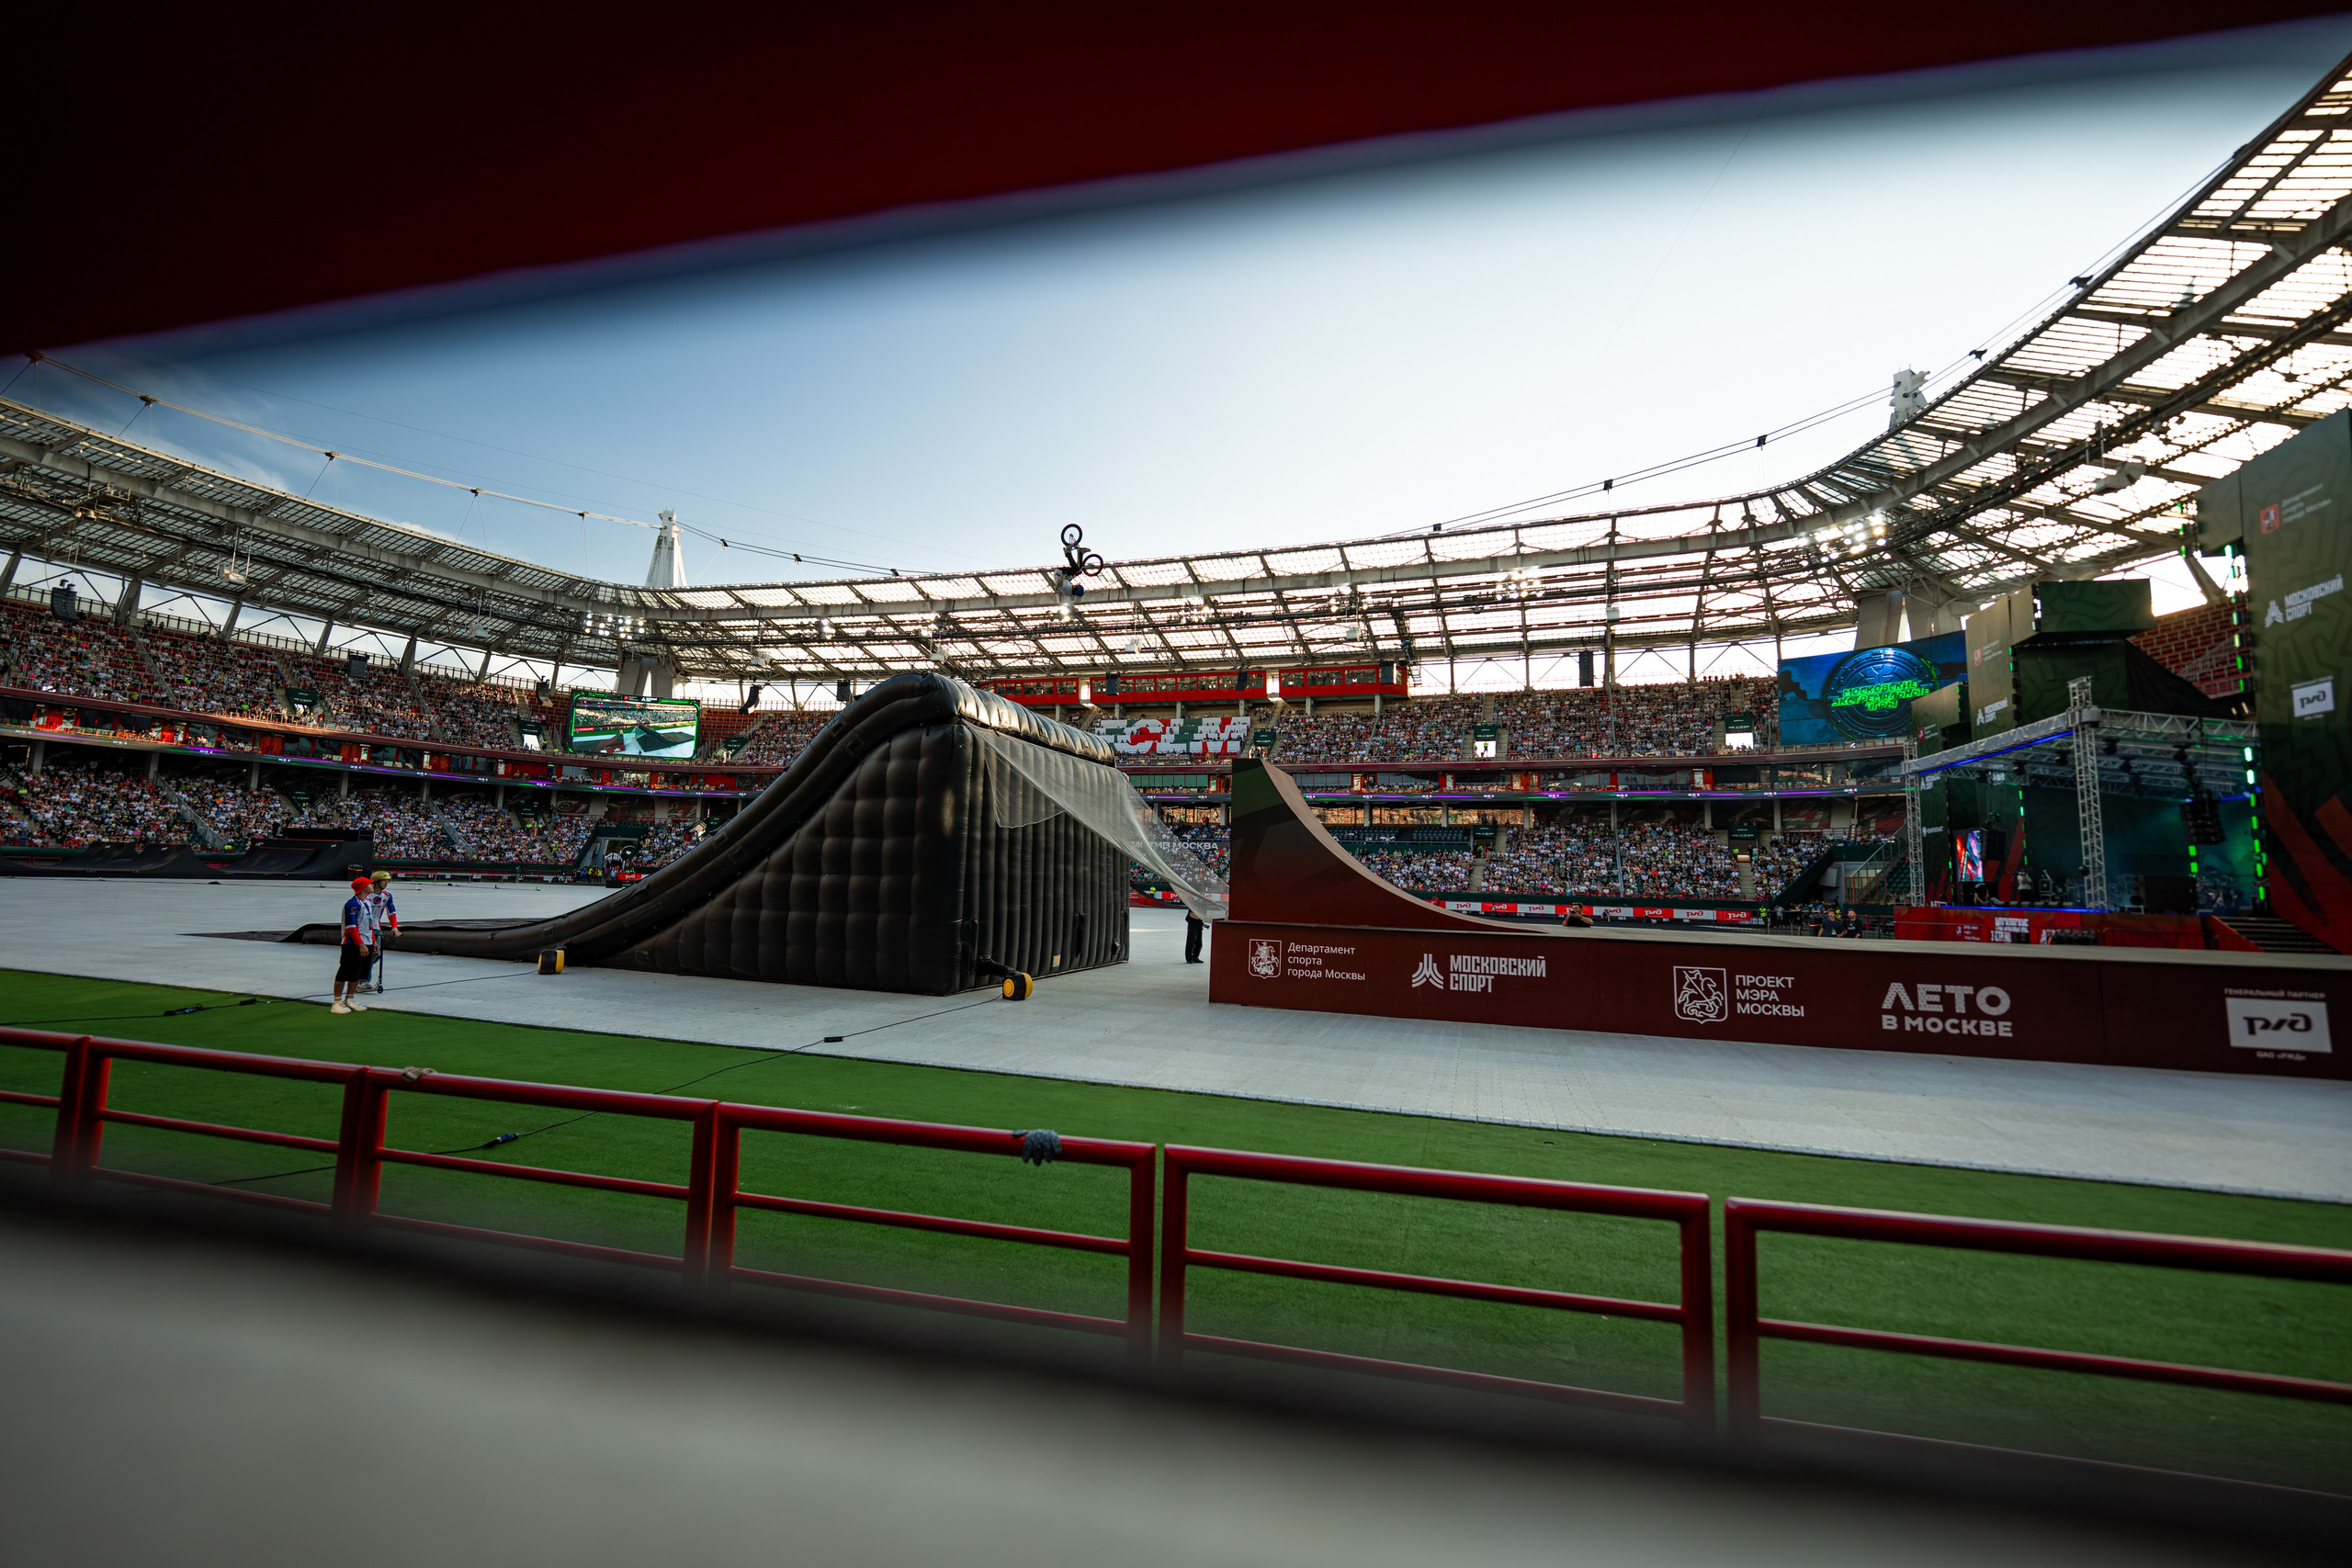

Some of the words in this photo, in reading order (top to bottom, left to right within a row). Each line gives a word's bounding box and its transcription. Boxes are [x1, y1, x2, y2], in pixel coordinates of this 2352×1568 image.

[2286, 602, 2312, 622] СПОРТ
[1843, 680, 1918, 697] МОСКОВСКИЕ
[1831, 687, 1929, 707] ЭКСТРЕМАЛЬНЫЕ
[1173, 841, 1218, 850] МОСКВА
[1287, 942, 1355, 955] Департамент
[1287, 956, 1322, 966] спорта
[1450, 954, 1546, 977] МОСКОВСКИЙ
[1287, 968, 1322, 979] города
[1325, 969, 1365, 980] Москвы
[1735, 975, 1794, 988] ПРОЕКТ
[1450, 973, 1495, 992] СПОРТ
[1736, 988, 1780, 1001] МЭРА
[1882, 982, 2011, 1016] ЛЕТО
[1736, 1002, 1804, 1017] МОСКВЫ
[1882, 1014, 1898, 1030] В
[1904, 1016, 2013, 1037] МОСКВЕ
